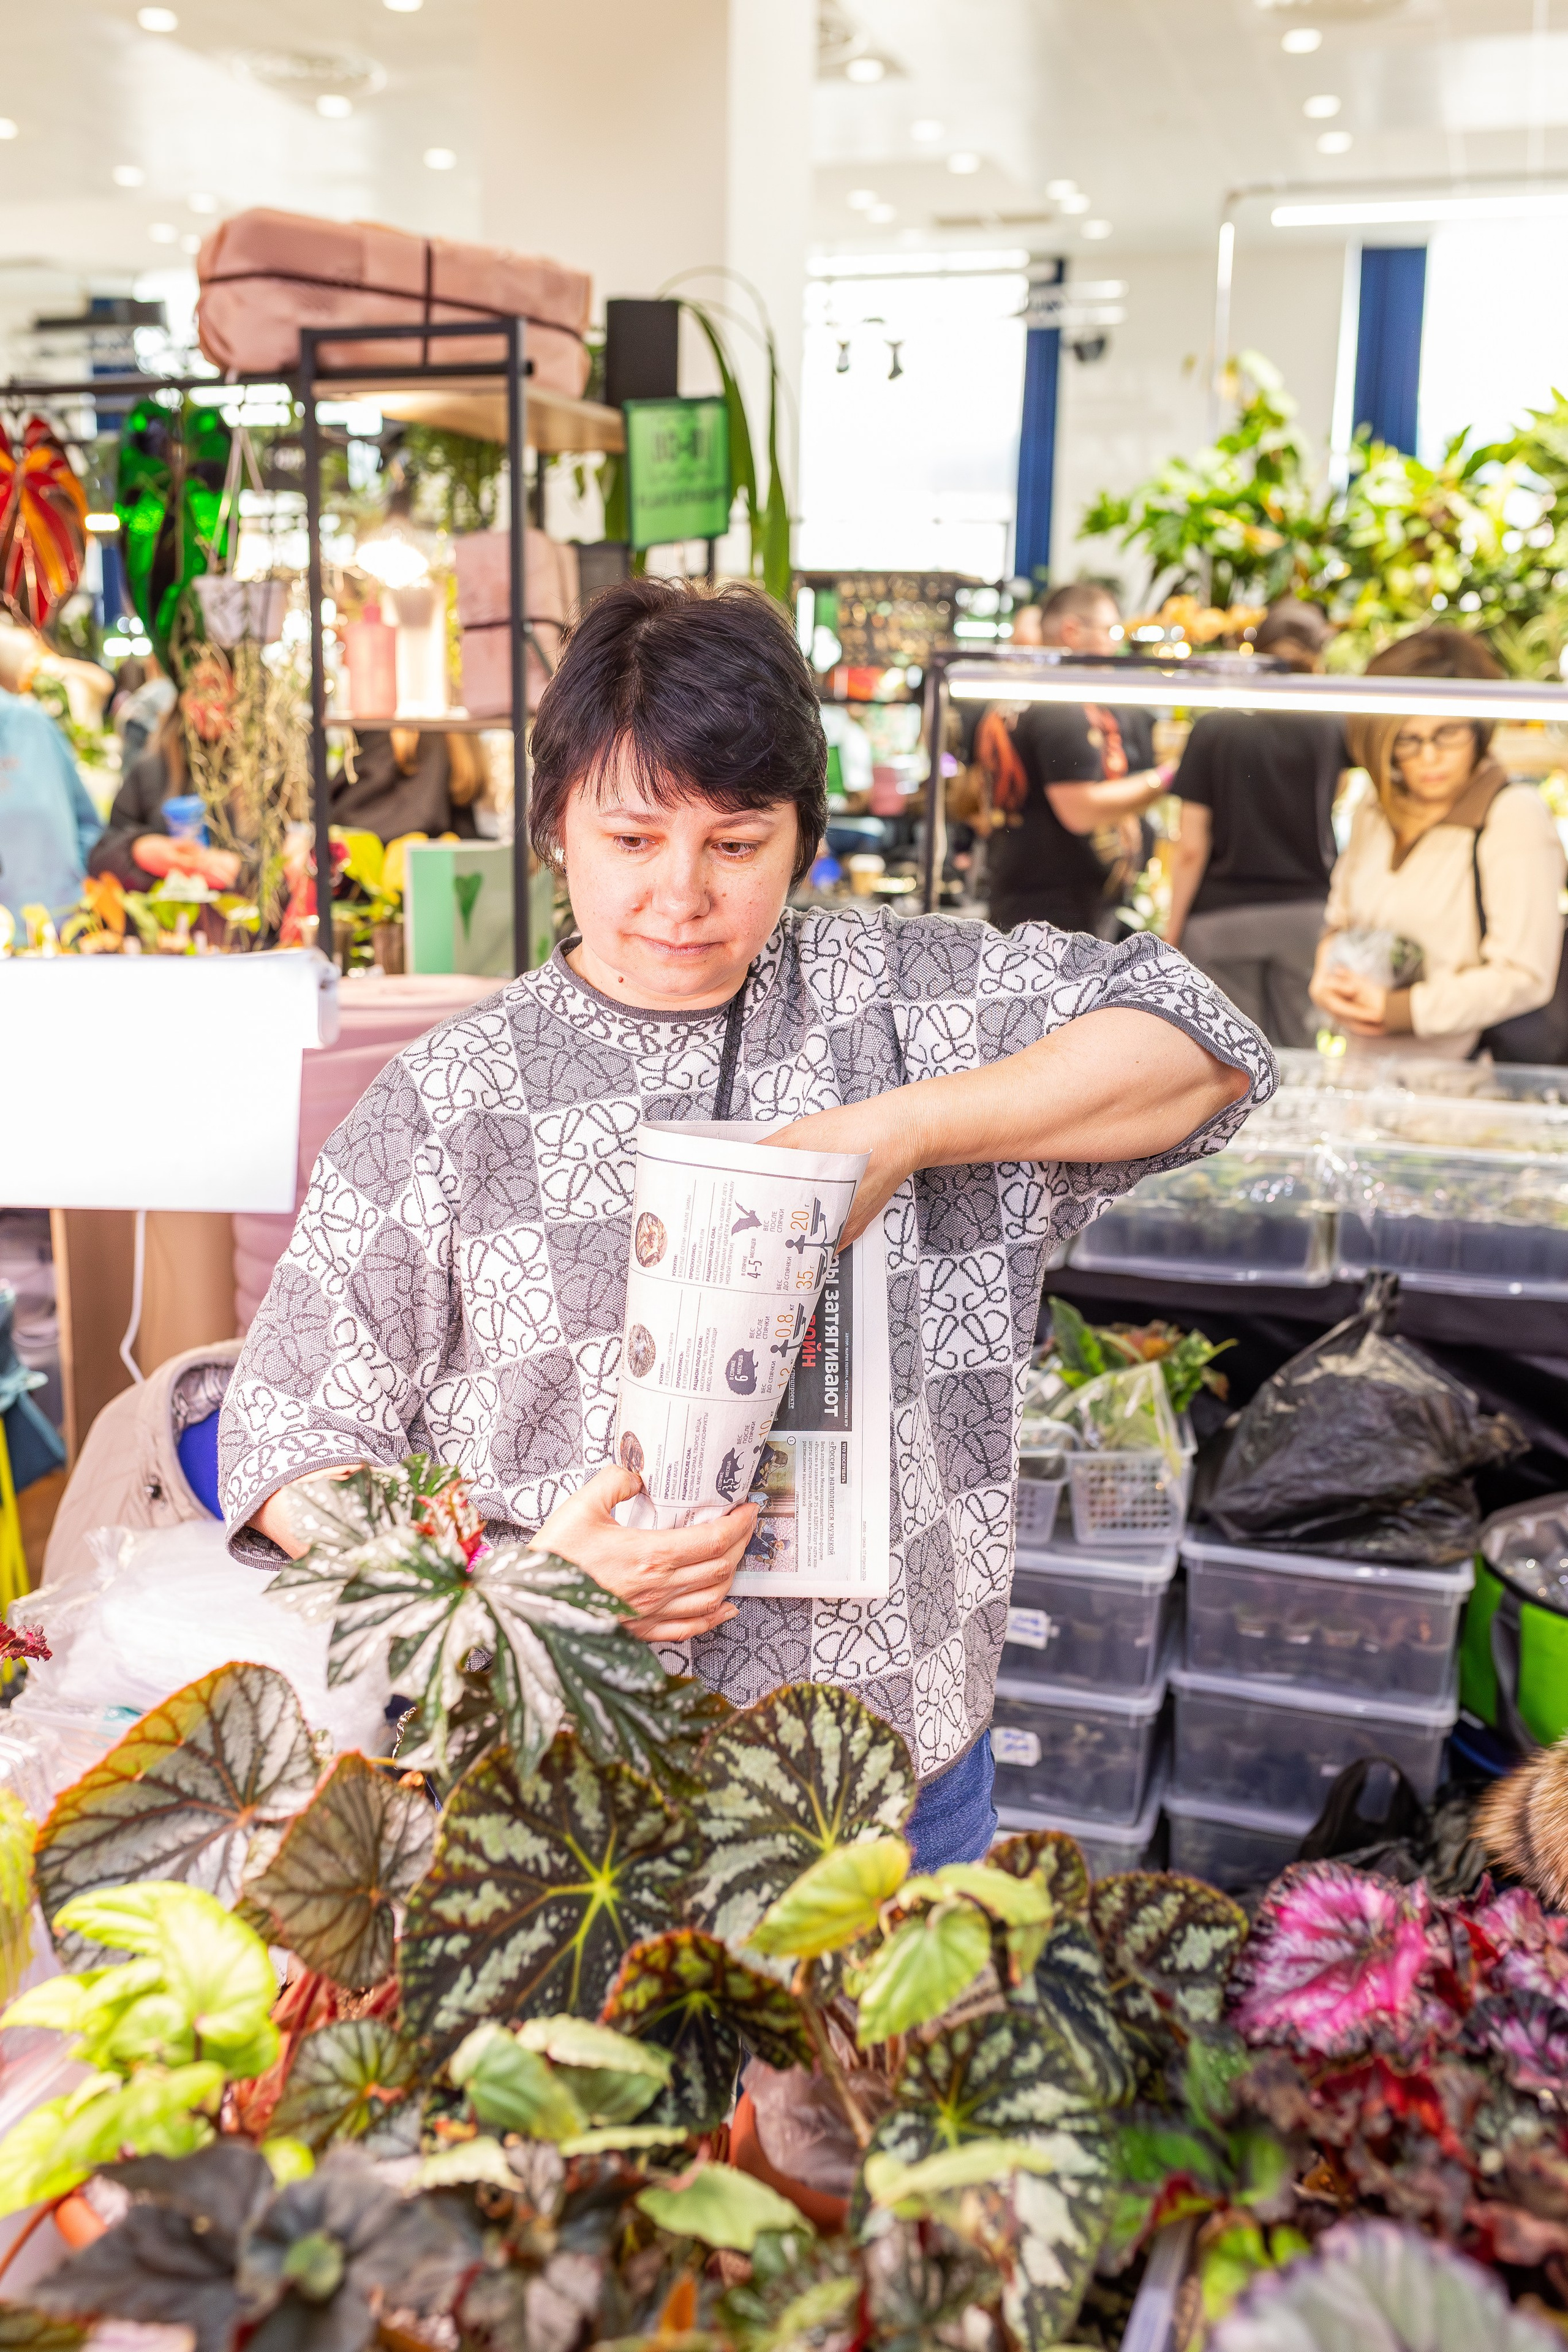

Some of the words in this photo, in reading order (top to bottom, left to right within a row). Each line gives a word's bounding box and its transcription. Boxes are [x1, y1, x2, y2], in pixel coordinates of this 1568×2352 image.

[790, 1211, 809, 1231] 20
[688, 1242, 697, 1279] ПРОСНУЛИСЬ:
[783, 1281, 789, 1291] ДО
[796, 1271, 813, 1289] 35
[775, 1315, 794, 1337] 0,8
[824, 1290, 839, 1417] затягивают
[758, 1420, 771, 1438] 10
[722, 1479, 734, 1490] 3,5
